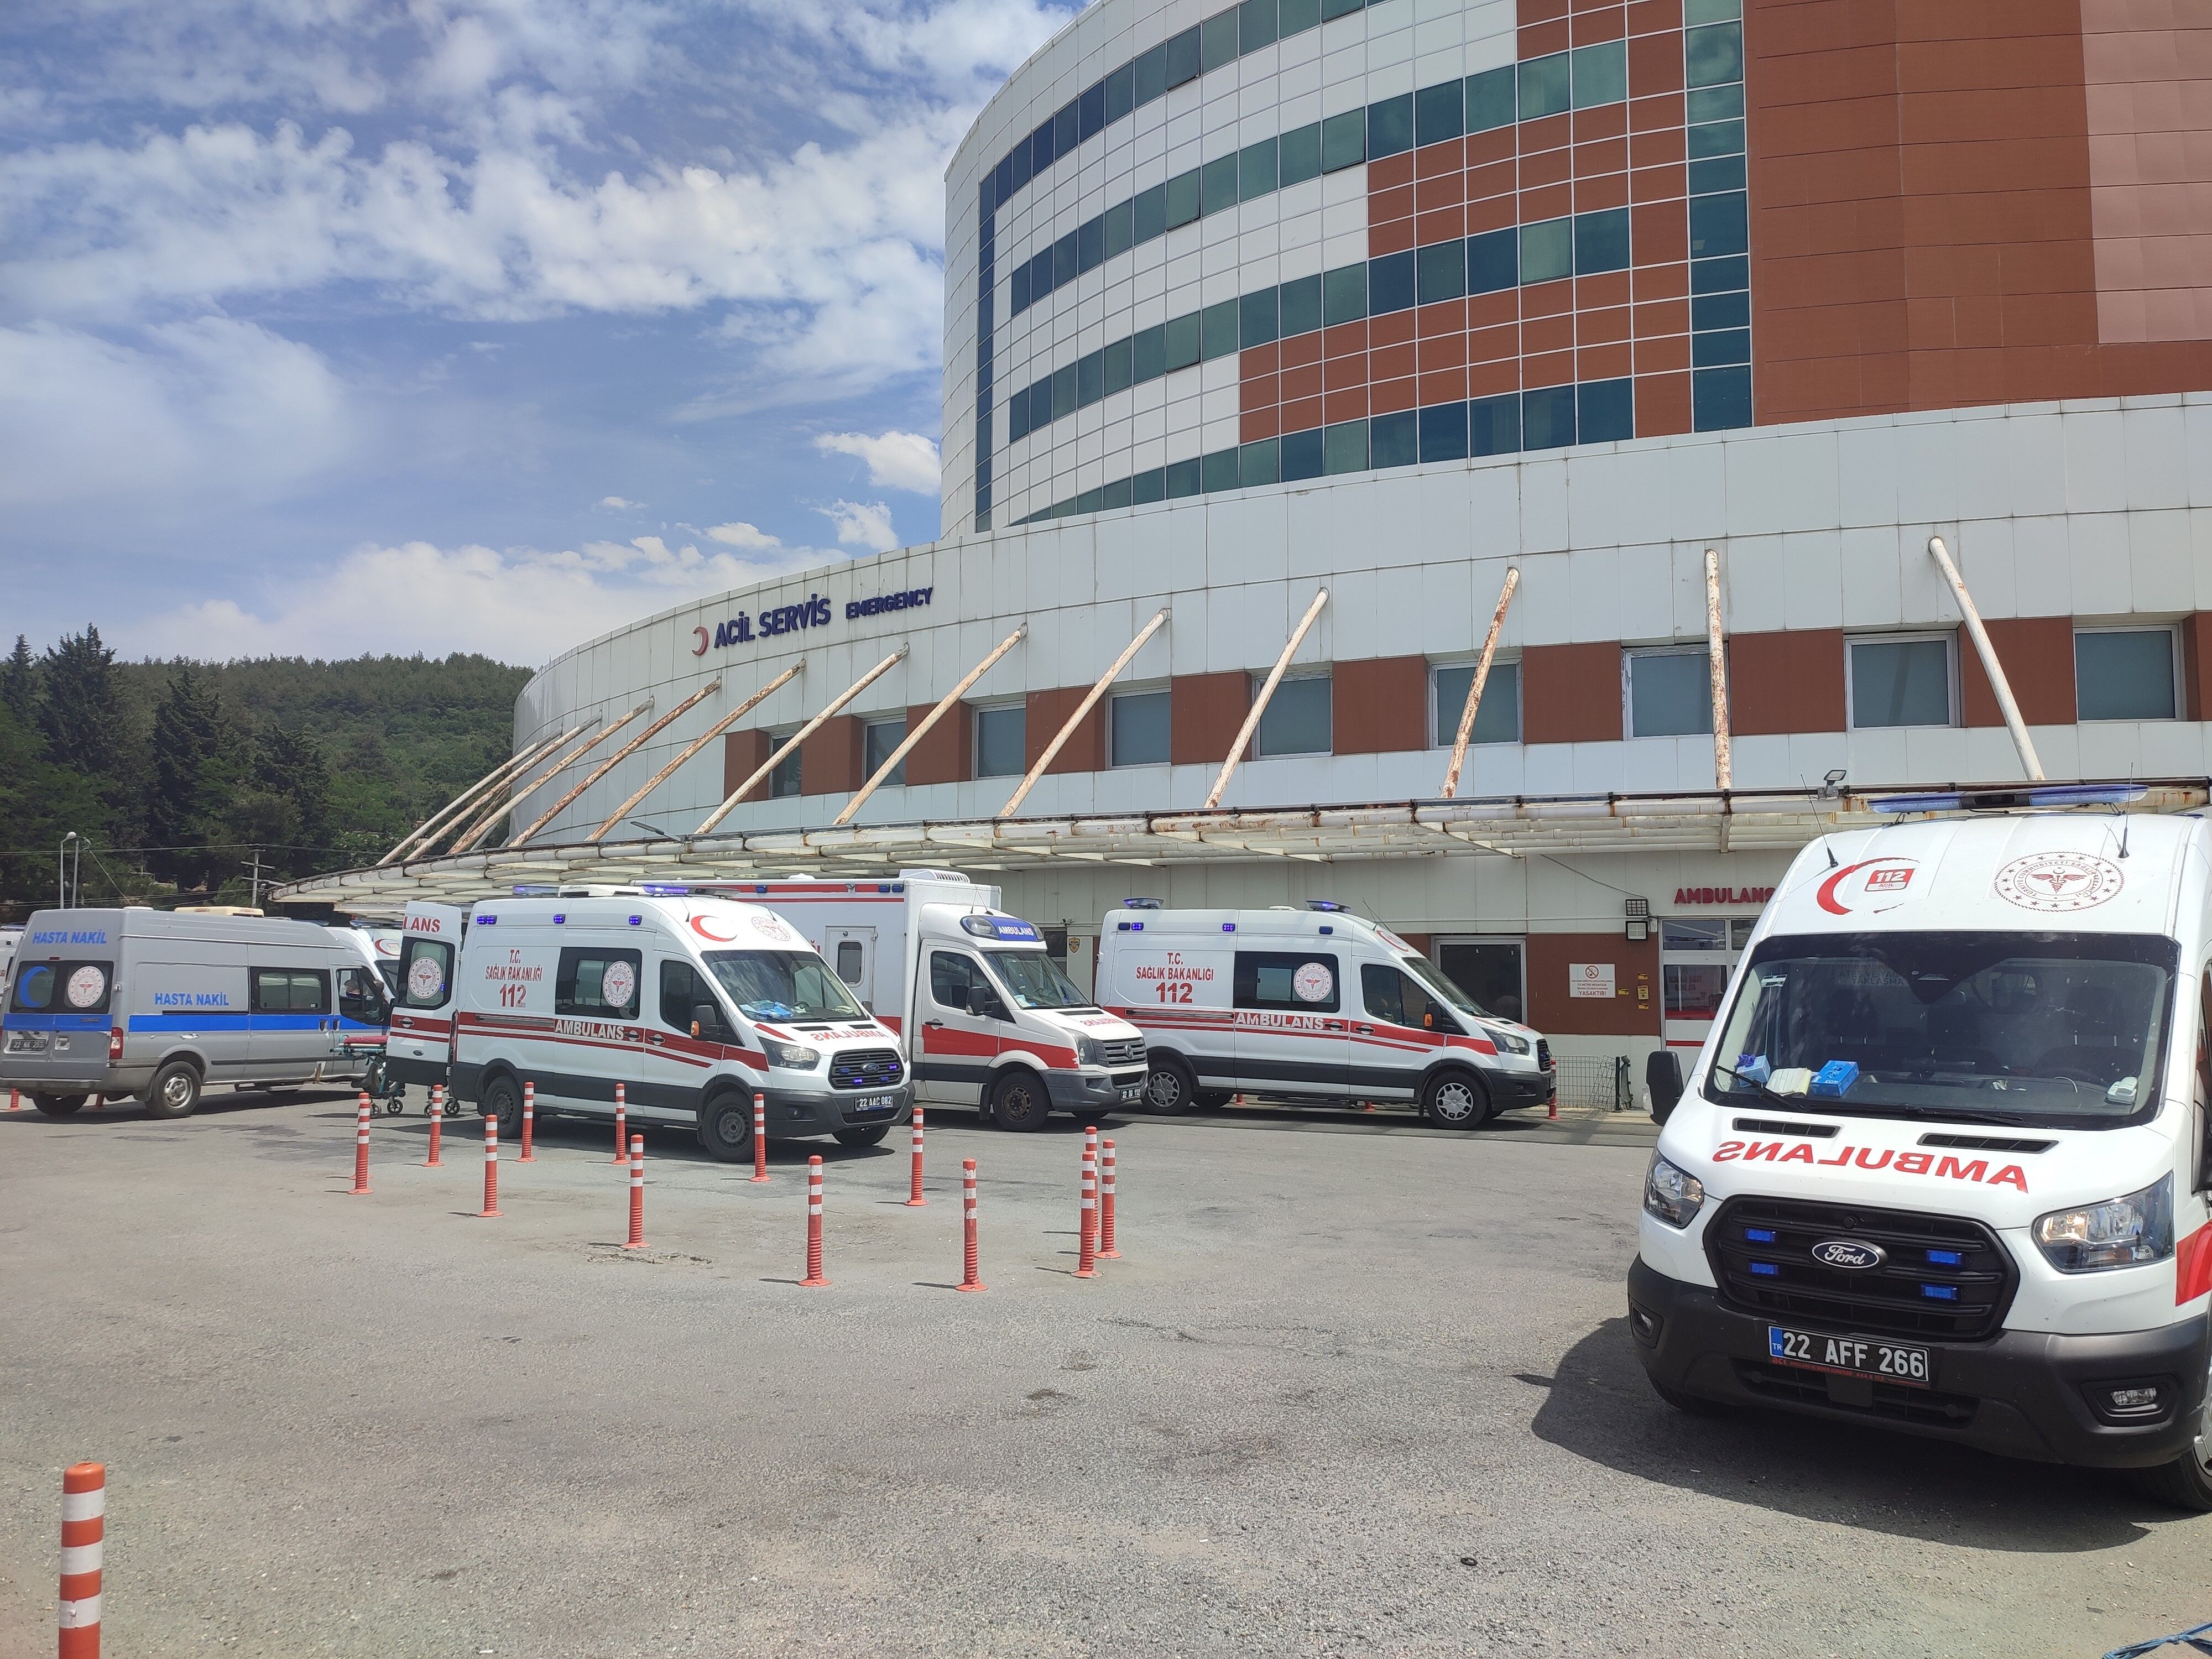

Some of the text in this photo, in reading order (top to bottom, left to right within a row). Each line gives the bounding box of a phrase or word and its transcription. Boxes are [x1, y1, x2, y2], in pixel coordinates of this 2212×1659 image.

[714, 587, 933, 649] ACİL SERVİS EMERGENCY
[1876, 871, 1906, 883] 112
[1674, 887, 1776, 904] AMBULANS
[32, 929, 107, 944] HASTA NAKİL
[998, 926, 1034, 936] AMBULANS
[509, 948, 521, 964] T.C.
[1167, 952, 1183, 965] T.C.
[485, 963, 543, 982] SAĞLIK BAKANLIĞI
[1136, 965, 1214, 981] SAĞLIK BAKANLIĞI
[155, 992, 229, 1006] HASTA NAKİL
[499, 983, 526, 1008] 112
[1156, 982, 1193, 1004] 112
[555, 1019, 624, 1040] AMBULANS
[1235, 1013, 1324, 1030] AMBULANS
[859, 1098, 868, 1107] 22
[881, 1096, 892, 1105] 082
[1825, 1245, 1865, 1265] Ford
[1772, 1343, 1782, 1351] TR
[1783, 1332, 1811, 1359] 22
[1825, 1339, 1868, 1368] AFF
[1879, 1347, 1924, 1377] 266
